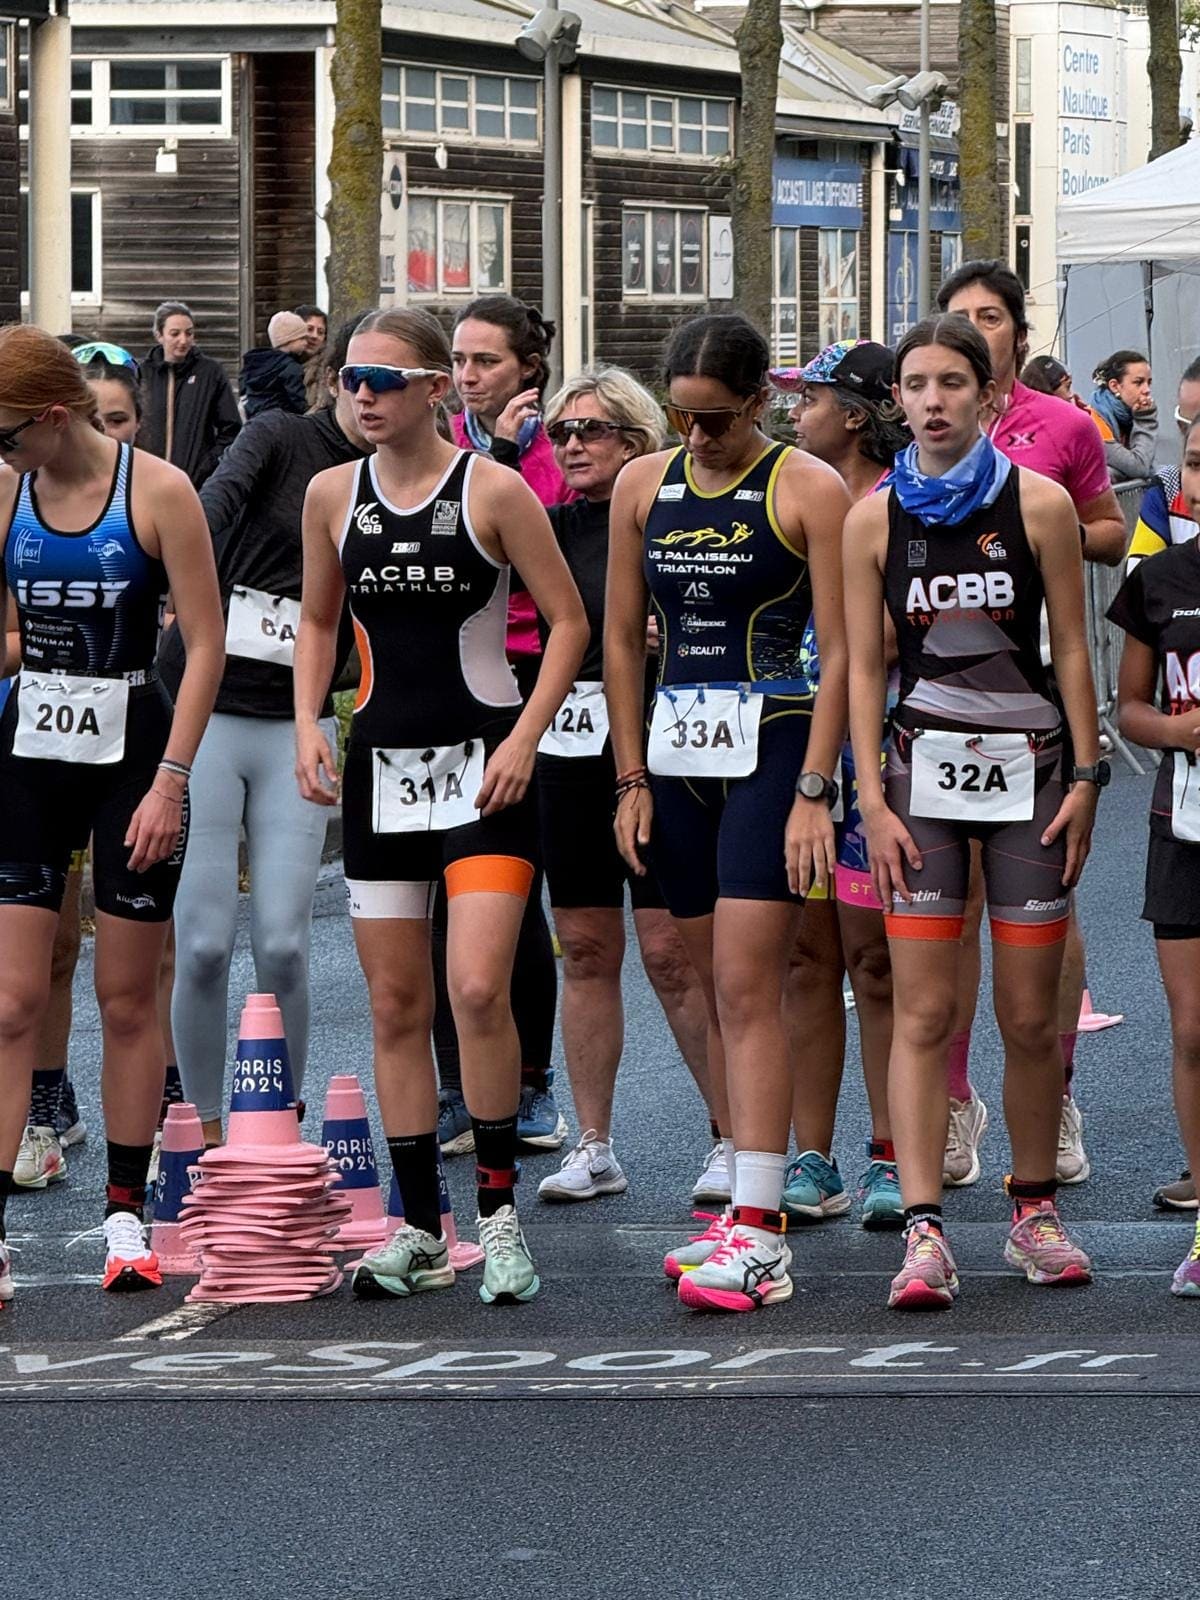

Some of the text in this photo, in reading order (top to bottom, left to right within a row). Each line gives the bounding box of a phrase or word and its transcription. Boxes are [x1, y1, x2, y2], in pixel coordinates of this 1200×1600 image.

[1063, 45, 1099, 74] Centre
[1063, 86, 1108, 119] Nautique
[1063, 127, 1090, 156] Paris
[361, 513, 380, 525] AC
[363, 524, 383, 534] BB
[986, 541, 1002, 550] AC
[648, 550, 753, 562] US PALAISEAU
[988, 549, 1007, 559] BB
[358, 565, 456, 582] ACBB
[656, 563, 737, 575] TRIATHLON
[350, 582, 471, 594] TRIATHLON
[906, 571, 1015, 614] ACBB
[26, 634, 74, 647] AQUAMAN
[690, 646, 727, 656] SCALITY
[35, 703, 101, 737] 20A
[670, 719, 735, 749] 33A
[937, 762, 1009, 793] 32A
[399, 772, 463, 806] 31A
